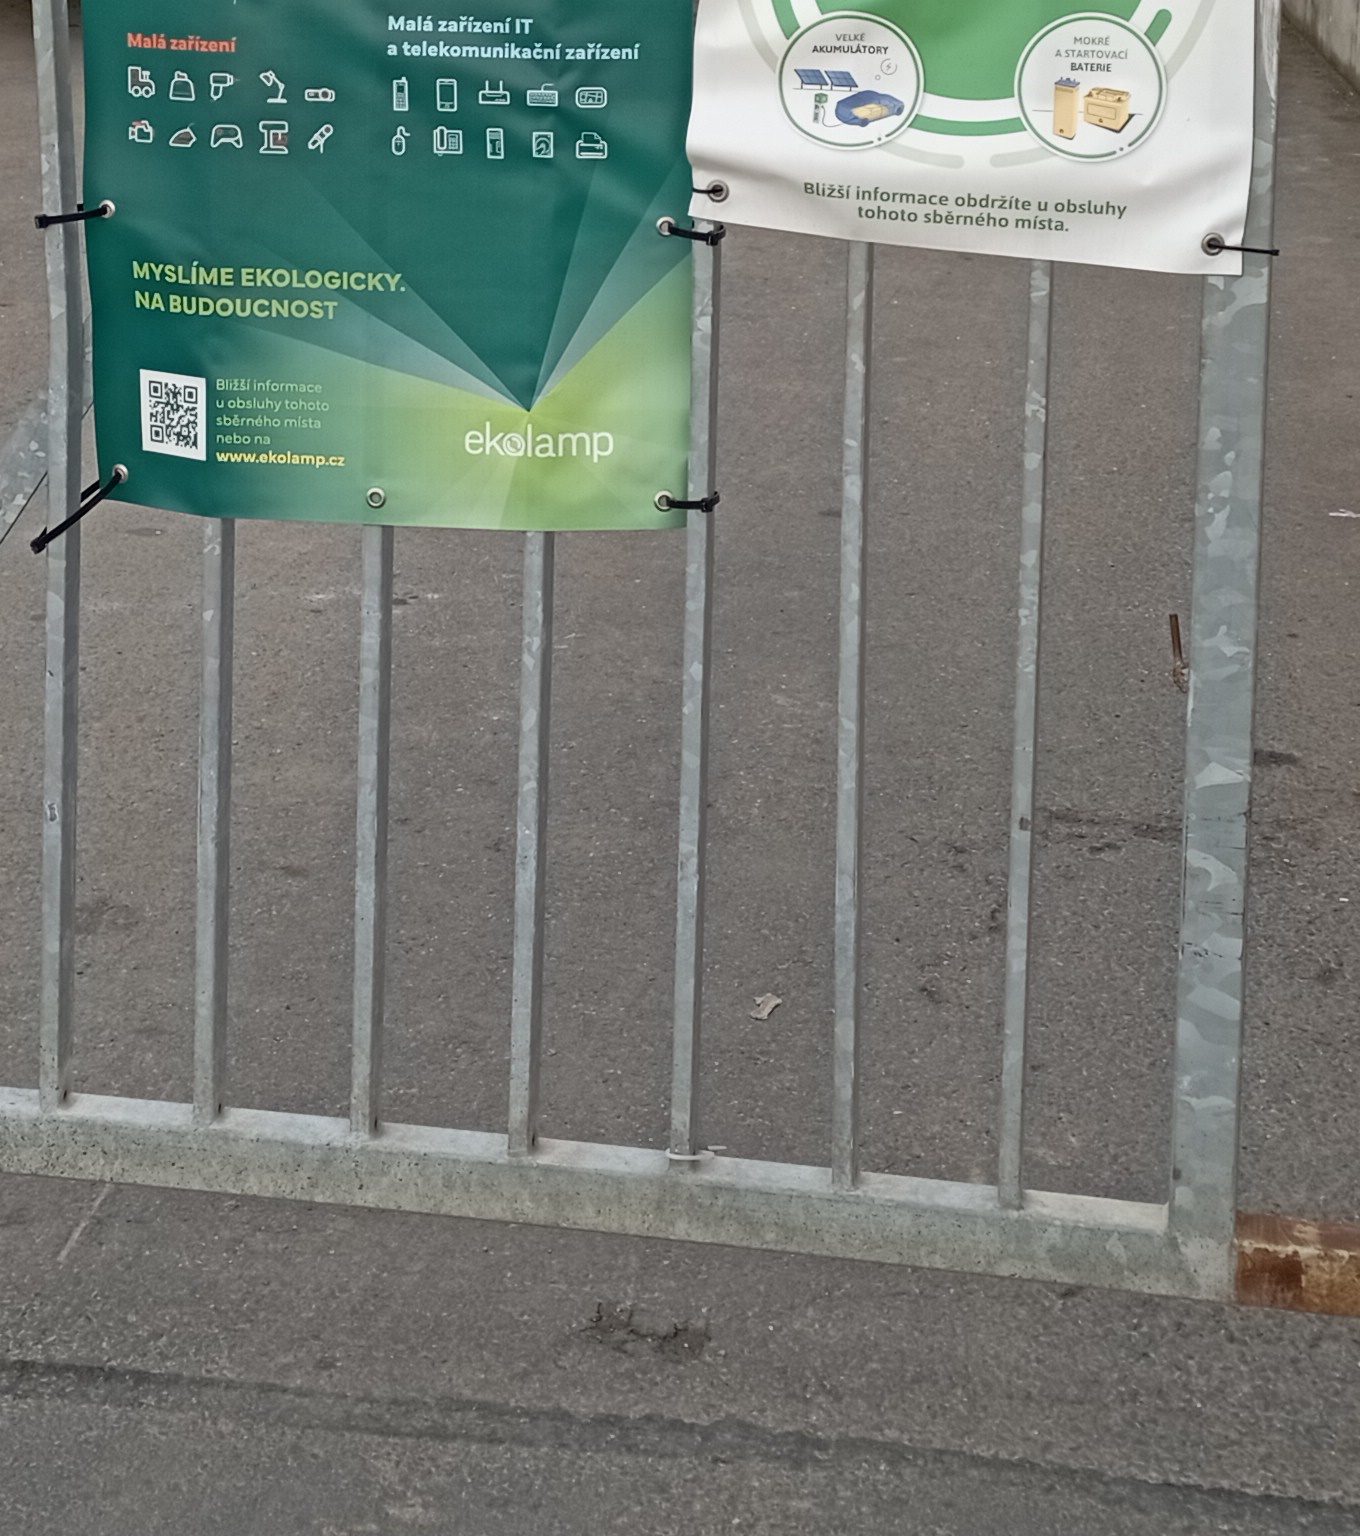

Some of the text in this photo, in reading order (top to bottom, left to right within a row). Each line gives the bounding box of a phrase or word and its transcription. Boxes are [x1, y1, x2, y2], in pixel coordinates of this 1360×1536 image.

[388, 16, 534, 34] Malá zařízení IT
[126, 32, 238, 53] Malá zařízení
[835, 33, 866, 42] VELKÉ
[1073, 36, 1110, 46] MOKRÉ
[387, 41, 641, 61] a telekomunikační zařízení
[812, 43, 889, 55] AKUMULÁTORY
[1055, 49, 1128, 60] A STARTOVACÍ
[1070, 62, 1112, 72] BATERIE
[803, 182, 1127, 220] Bližší informace obdržíte u obsluhy
[858, 205, 1069, 232] tohoto sběrného místa.
[132, 261, 407, 293] MYSLÍME EKOLOGICKY.
[134, 290, 339, 320] NA BUDOUCNOST
[216, 378, 322, 394] Bližší informace
[216, 396, 330, 413] u obsluhy tohoto
[216, 414, 322, 429] sběrného místa
[216, 432, 271, 445] nebo na
[464, 421, 615, 463] ekolamp
[216, 450, 345, 469] www.ekolamp.cz
